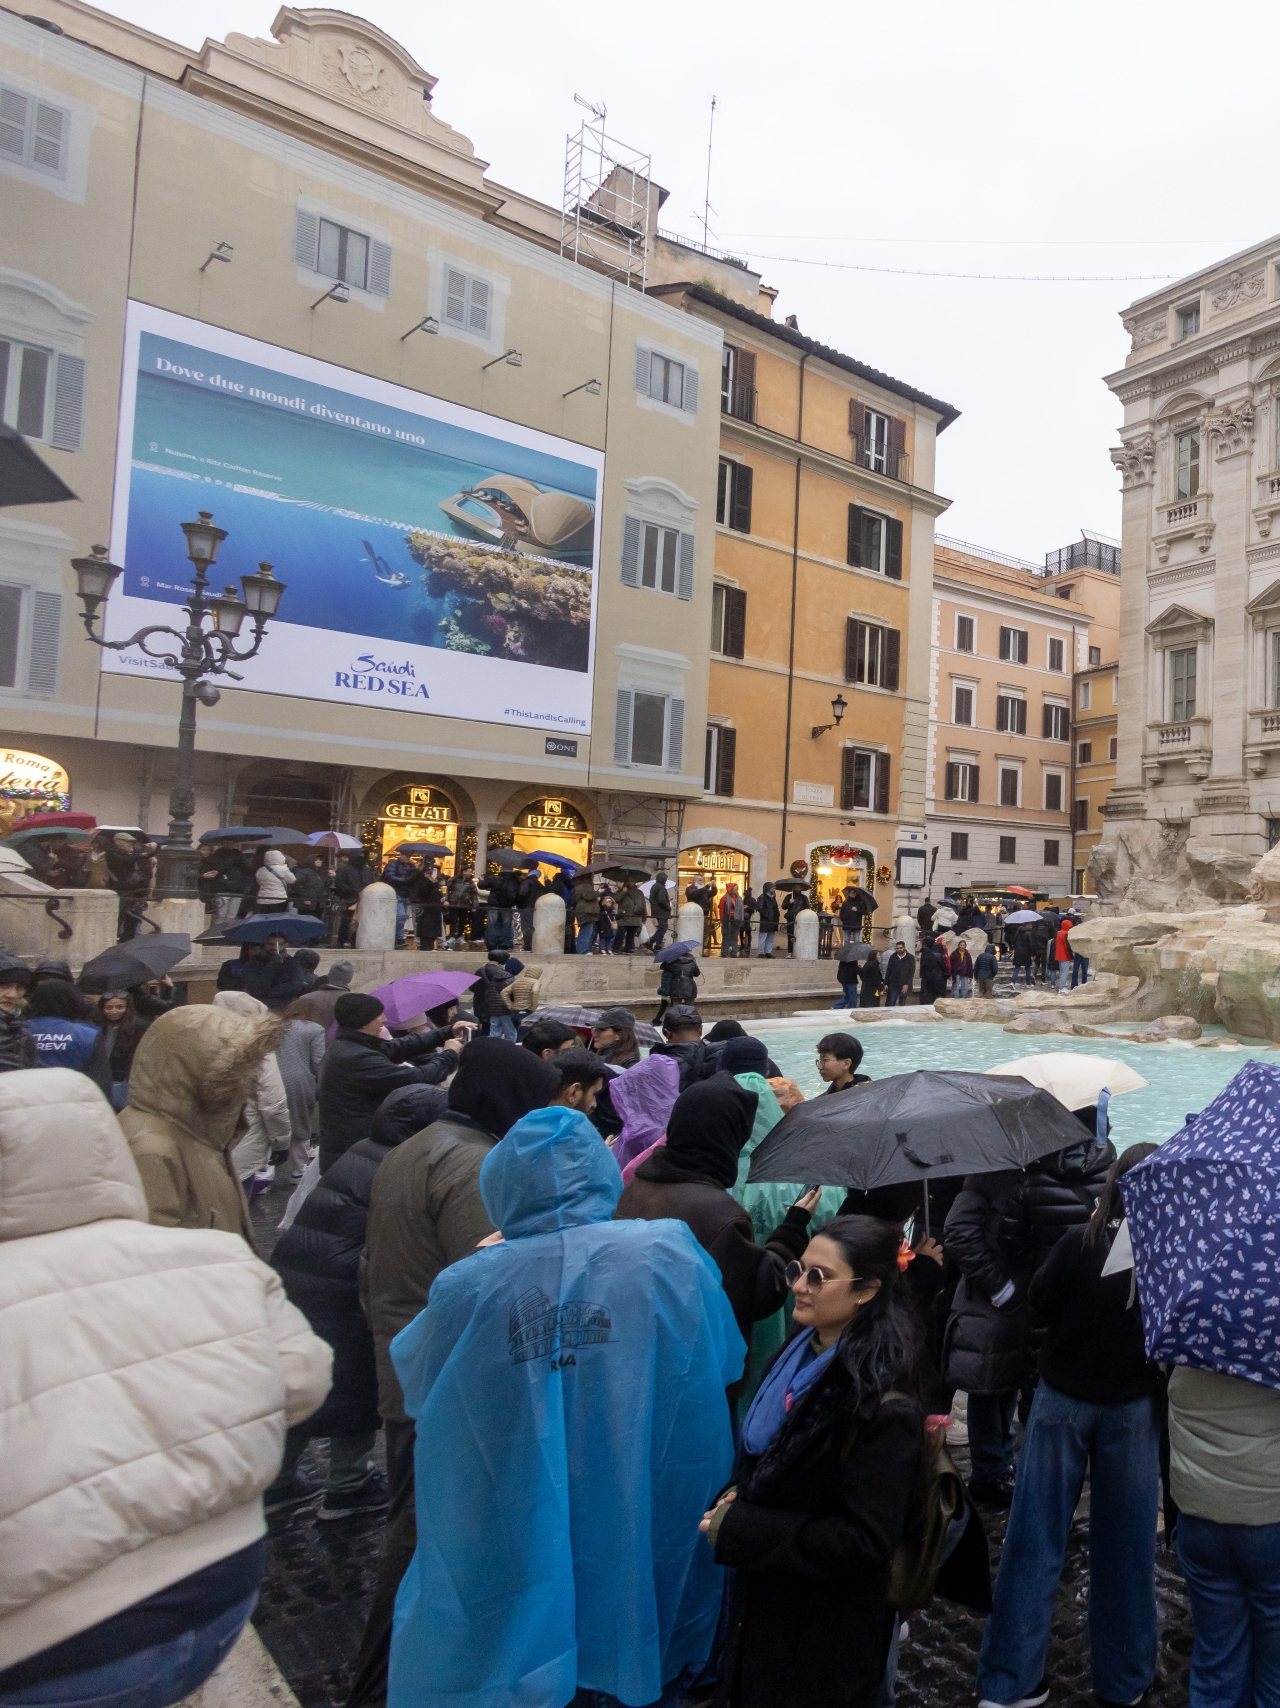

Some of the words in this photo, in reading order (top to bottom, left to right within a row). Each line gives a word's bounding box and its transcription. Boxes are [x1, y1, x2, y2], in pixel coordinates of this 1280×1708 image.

[157, 357, 205, 381] Dove
[209, 374, 245, 393] due
[249, 387, 306, 411] mondi
[310, 403, 392, 435] diventano
[395, 429, 426, 445] uno
[156, 581, 173, 590] Mar
[351, 653, 416, 677] Saudi
[335, 671, 385, 692] RED
[388, 679, 430, 699] SEA
[503, 708, 586, 727] #ThisLandIsCalling
[557, 743, 577, 753] ONE
[4, 753, 51, 772] Roma
[386, 803, 450, 820] GELATI
[527, 814, 576, 830] PIZZA
